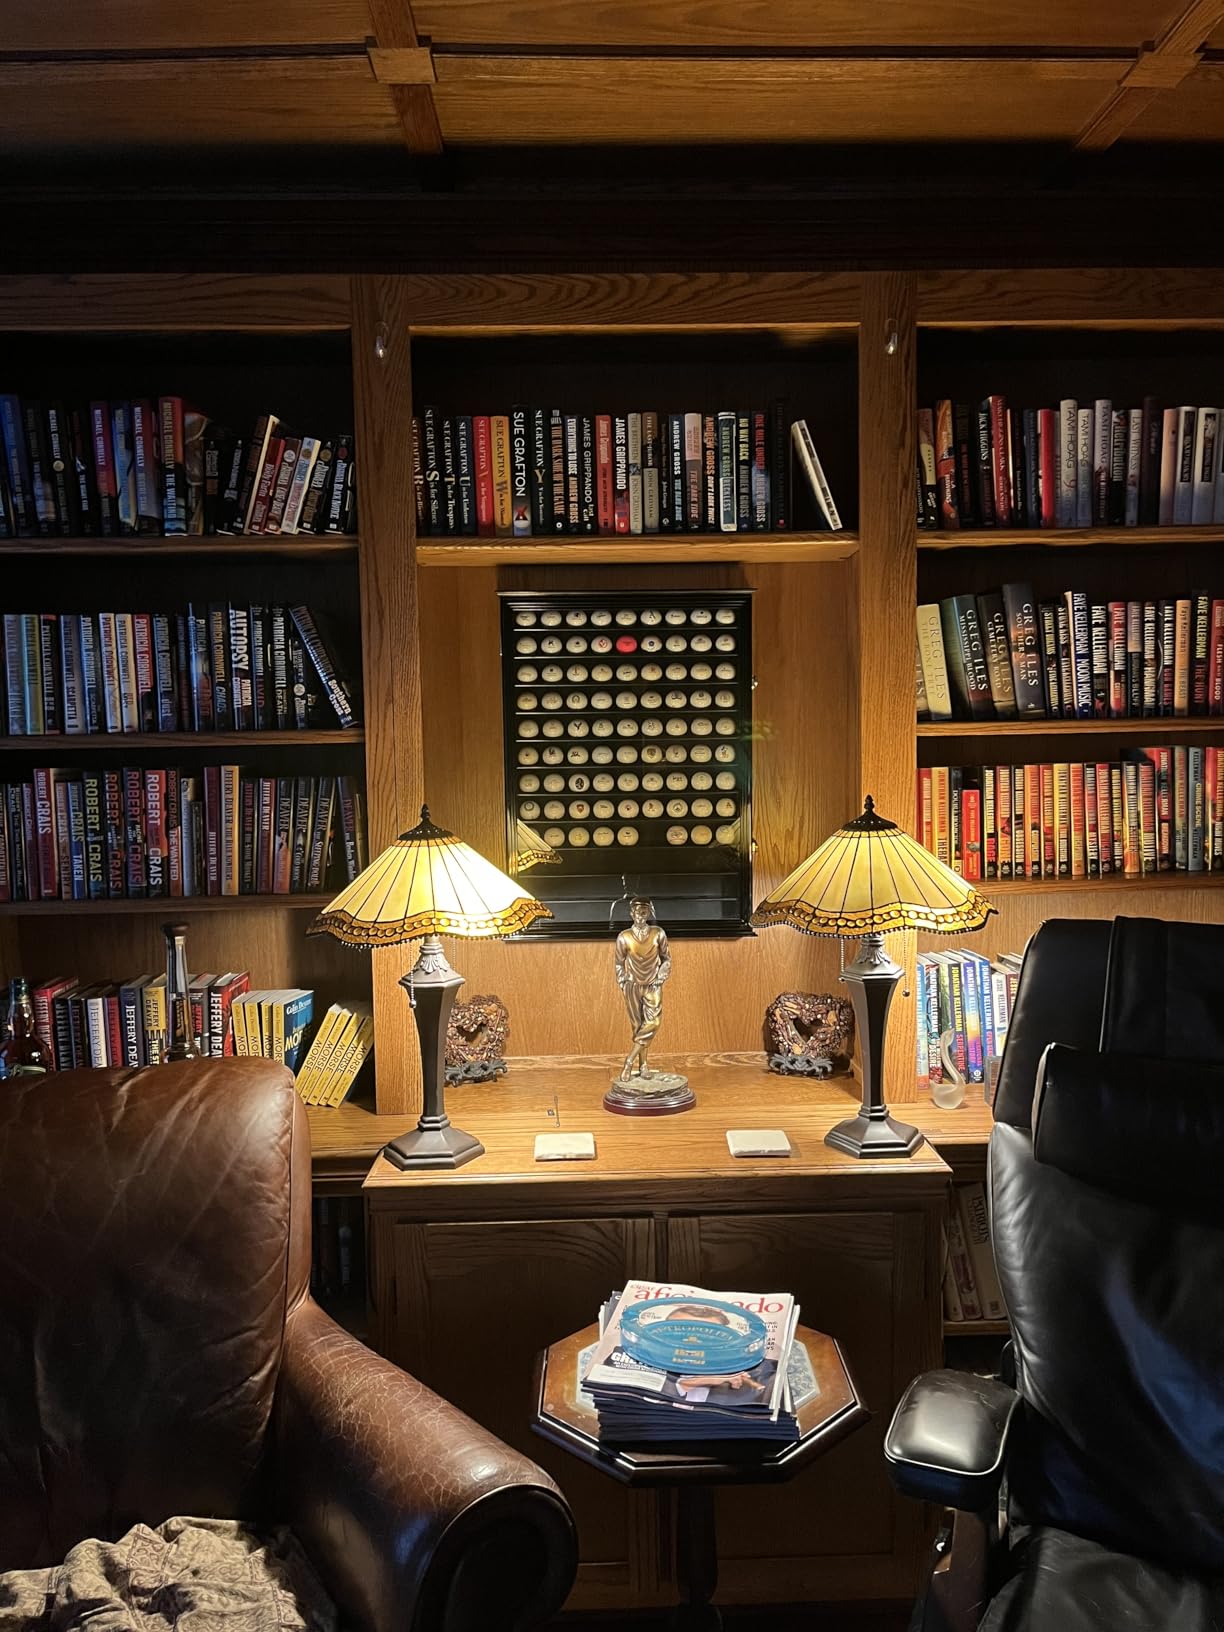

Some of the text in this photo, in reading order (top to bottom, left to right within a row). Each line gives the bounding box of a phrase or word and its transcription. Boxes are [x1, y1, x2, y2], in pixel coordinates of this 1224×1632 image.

[94, 409, 106, 466] MICHAEL CONNELLY
[162, 402, 174, 434] MICHAEL
[424, 409, 434, 427] SUE
[535, 409, 546, 467] SUE GRAFTON
[978, 412, 991, 461] JACK HIGGINS
[1065, 404, 1076, 469] TAMI HOAG
[1081, 414, 1090, 467] TAMI HOAG
[164, 434, 175, 470] CONNELLY
[425, 427, 438, 469] GRAFTON
[478, 419, 488, 471] SUE GRAFTON
[513, 411, 527, 497] SUE GRAFTON
[582, 417, 593, 503] JAMES GRIPPANDO
[615, 417, 627, 490] JAMES GRIPPANDO
[1130, 416, 1141, 471] LAST WITNESS
[165, 473, 176, 487] THE
[331, 483, 344, 501] BLACK
[425, 470, 441, 482] S
[567, 418, 580, 524] EVERYTHING TO LOSE ANDREW GROSS
[721, 426, 732, 512] ANDREW GROSS RECKLESS
[430, 499, 439, 526] Silence
[229, 608, 250, 670] AUTOPSY
[1091, 605, 1109, 675] FAYE KELLERMAN
[1113, 607, 1126, 625] FAYE
[101, 616, 116, 686] PATRICIA CORNWELL
[135, 618, 152, 694] PATRICIA CORNWELL
[155, 617, 173, 717] PATRICIA CORNWELL dust
[211, 611, 227, 713] PATRICIA CORNWELL CHAOS
[253, 620, 265, 708] PATRICIA CORNWELL LIVID
[272, 616, 288, 689] PATRICIA CORNWELL
[928, 616, 947, 700] GREG ILES
[959, 614, 977, 691] MISSISSIPPI BLOOD
[966, 609, 989, 691] GREG ILES
[987, 621, 1003, 689] CEMETERY ROAD
[993, 611, 1013, 693] GREG ILES
[1015, 612, 1027, 680] SOUTHERN MAN
[1022, 603, 1039, 687] GREG ILES
[1073, 592, 1093, 708] FAYE KELLERMAN MOON MUSIC
[1114, 628, 1128, 671] KELLERMAN
[1193, 596, 1209, 705] FAYE KELLERMAN THE HUNT
[1215, 643, 1223, 664] FLESH
[232, 677, 242, 708] CORNWELL
[241, 679, 253, 706] PATRICIA
[275, 688, 284, 715] DEATH
[328, 679, 353, 715] Southern
[329, 693, 345, 716] Cross
[1214, 677, 1223, 701] BLOOD
[1192, 751, 1200, 782] KELLERMAN
[37, 771, 52, 835] ROBERT CRAIS
[262, 781, 271, 831] JEFFERY DEAVER
[279, 797, 291, 831] DEAVER
[297, 797, 310, 831] DEAVER
[985, 769, 997, 863] JONATHAN KELLERMAN RAGE
[1160, 781, 1169, 816] KELLERMAN
[1214, 750, 1224, 856] JONATHAN KELLERMAN NIGHT MOVES
[84, 778, 103, 882] ROBERT CRAIS
[105, 773, 123, 889] ROBERT CRAIS
[127, 771, 142, 882] ROBERT CRAIS
[147, 773, 164, 886] ROBERT CRAIS
[168, 770, 180, 881] ROBERT CRAIS THE WANTED
[1089, 831, 1099, 861] MYSTERY
[1143, 832, 1156, 862] MOTIVE
[1192, 829, 1200, 859] KELLERMAN
[61, 855, 71, 887] SENTRY
[208, 831, 218, 881] JEFFERY DEAVER
[90, 1007, 100, 1046] JEFFERY
[125, 1004, 137, 1044] JEFFERY
[151, 998, 159, 1027] JEFFERY
[210, 992, 223, 1034] JEFFERY
[952, 966, 966, 1072] JONATHAN KELLERMAN SERPENTINE
[998, 994, 1006, 1024] KELLERMAN
[303, 1040, 323, 1072] MORSE
[315, 1042, 334, 1073] MORSE
[325, 1043, 345, 1074] MORSE
[337, 1044, 358, 1074] MORSE
[347, 1044, 368, 1076] MORSE
[929, 1044, 938, 1068] DESIRE
